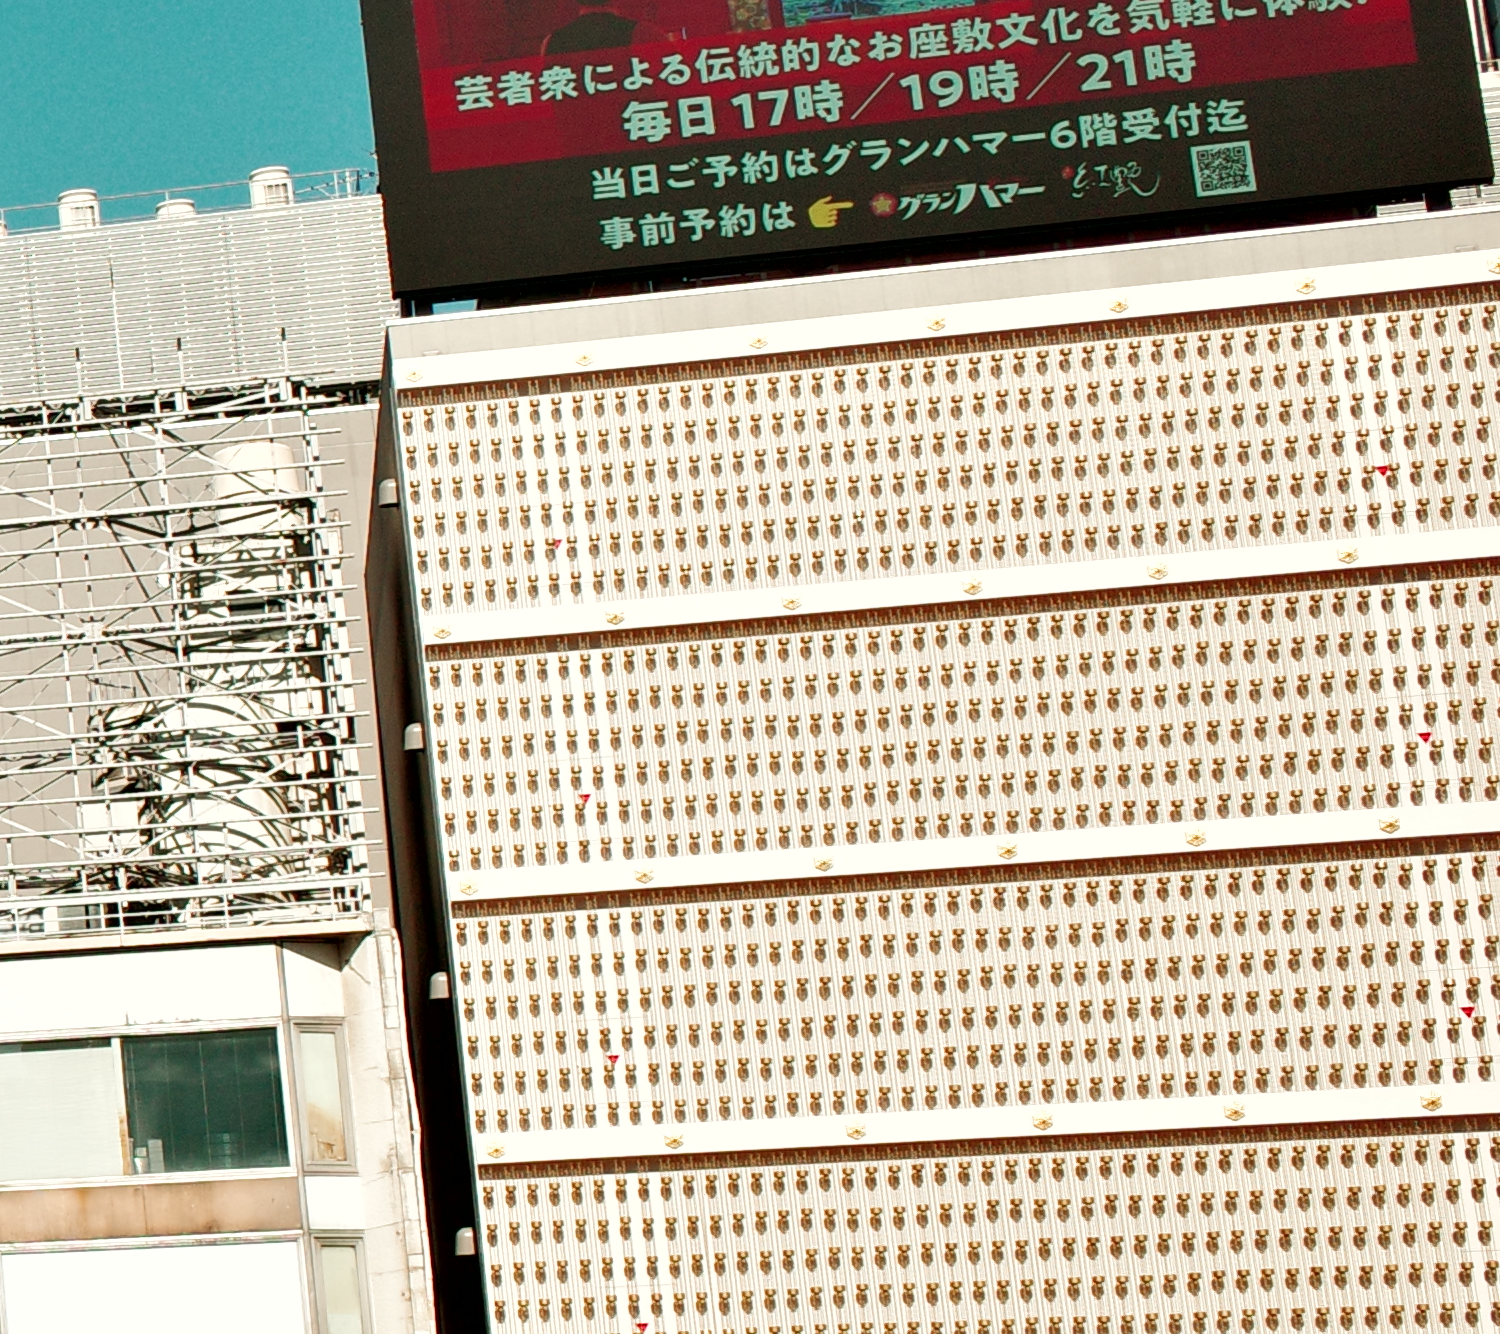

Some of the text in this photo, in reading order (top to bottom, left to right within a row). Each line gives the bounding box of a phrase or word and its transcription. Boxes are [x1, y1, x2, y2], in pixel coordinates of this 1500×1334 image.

[590, 98, 1249, 200] 当日ご予約はグランハマー6階受付迄
[599, 199, 797, 250] 事前予約は
